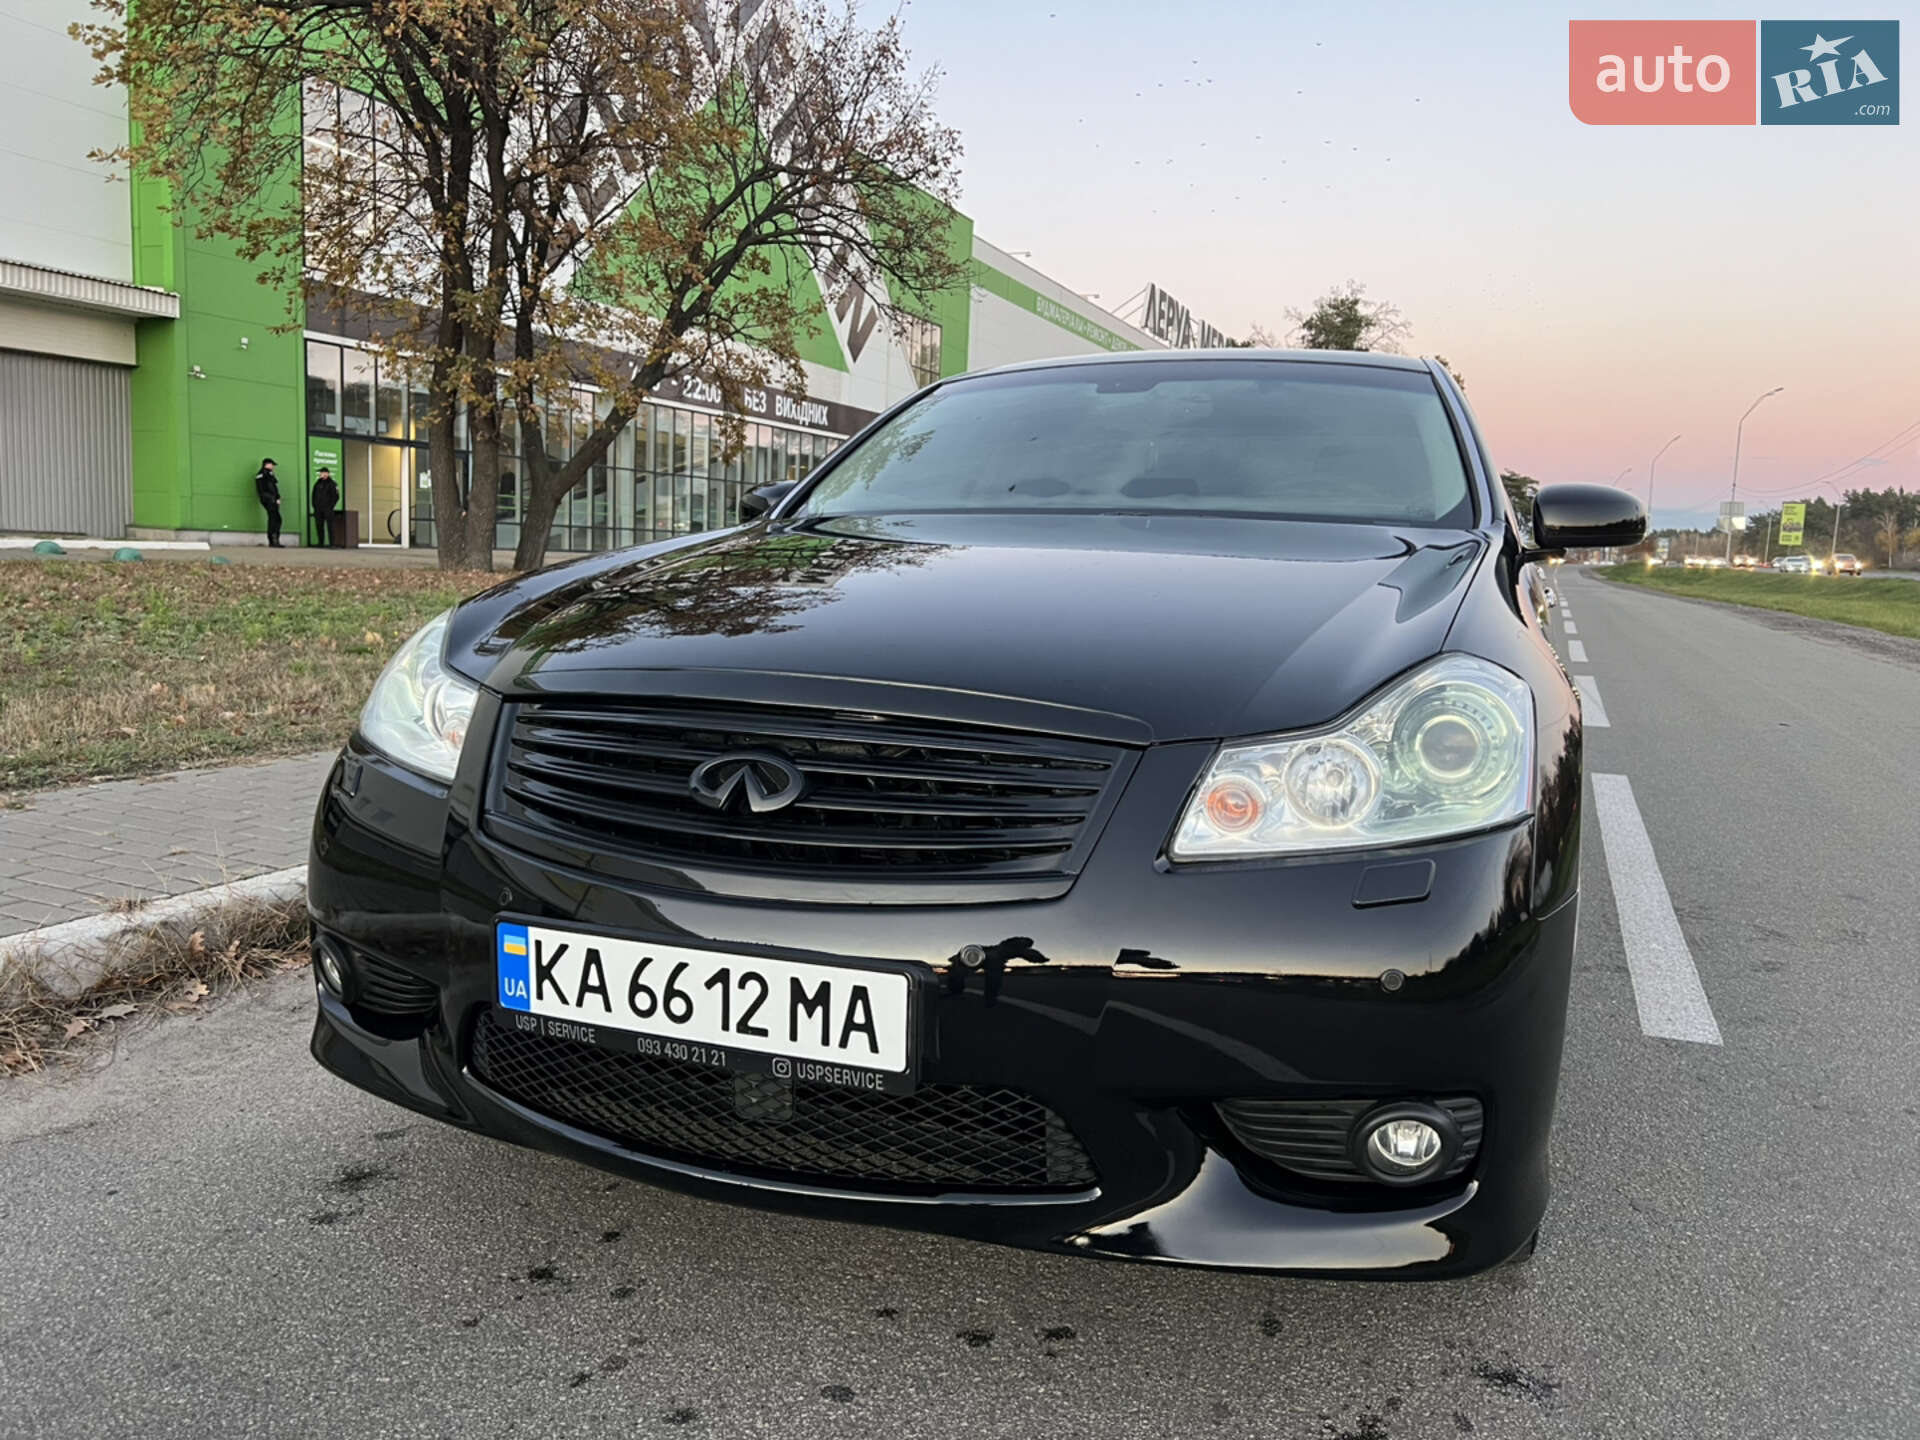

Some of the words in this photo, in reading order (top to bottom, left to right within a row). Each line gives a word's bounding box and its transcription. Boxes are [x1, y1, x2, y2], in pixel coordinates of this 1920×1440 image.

[1143, 283, 1191, 348] ЛЕРУА
[744, 388, 767, 413] БЕЗ
[775, 395, 829, 426] ВИХІДНИХ
[504, 976, 528, 1000] UA
[534, 939, 613, 1013] KA
[627, 957, 770, 1038] 6612
[789, 976, 880, 1054] MA
[515, 1014, 538, 1031] USP
[547, 1020, 596, 1044] SERVICE
[637, 1037, 662, 1056] 093
[664, 1042, 689, 1061] 430
[691, 1047, 708, 1064] 21
[710, 1050, 727, 1067] 21
[796, 1063, 885, 1091] USPSERVICE
